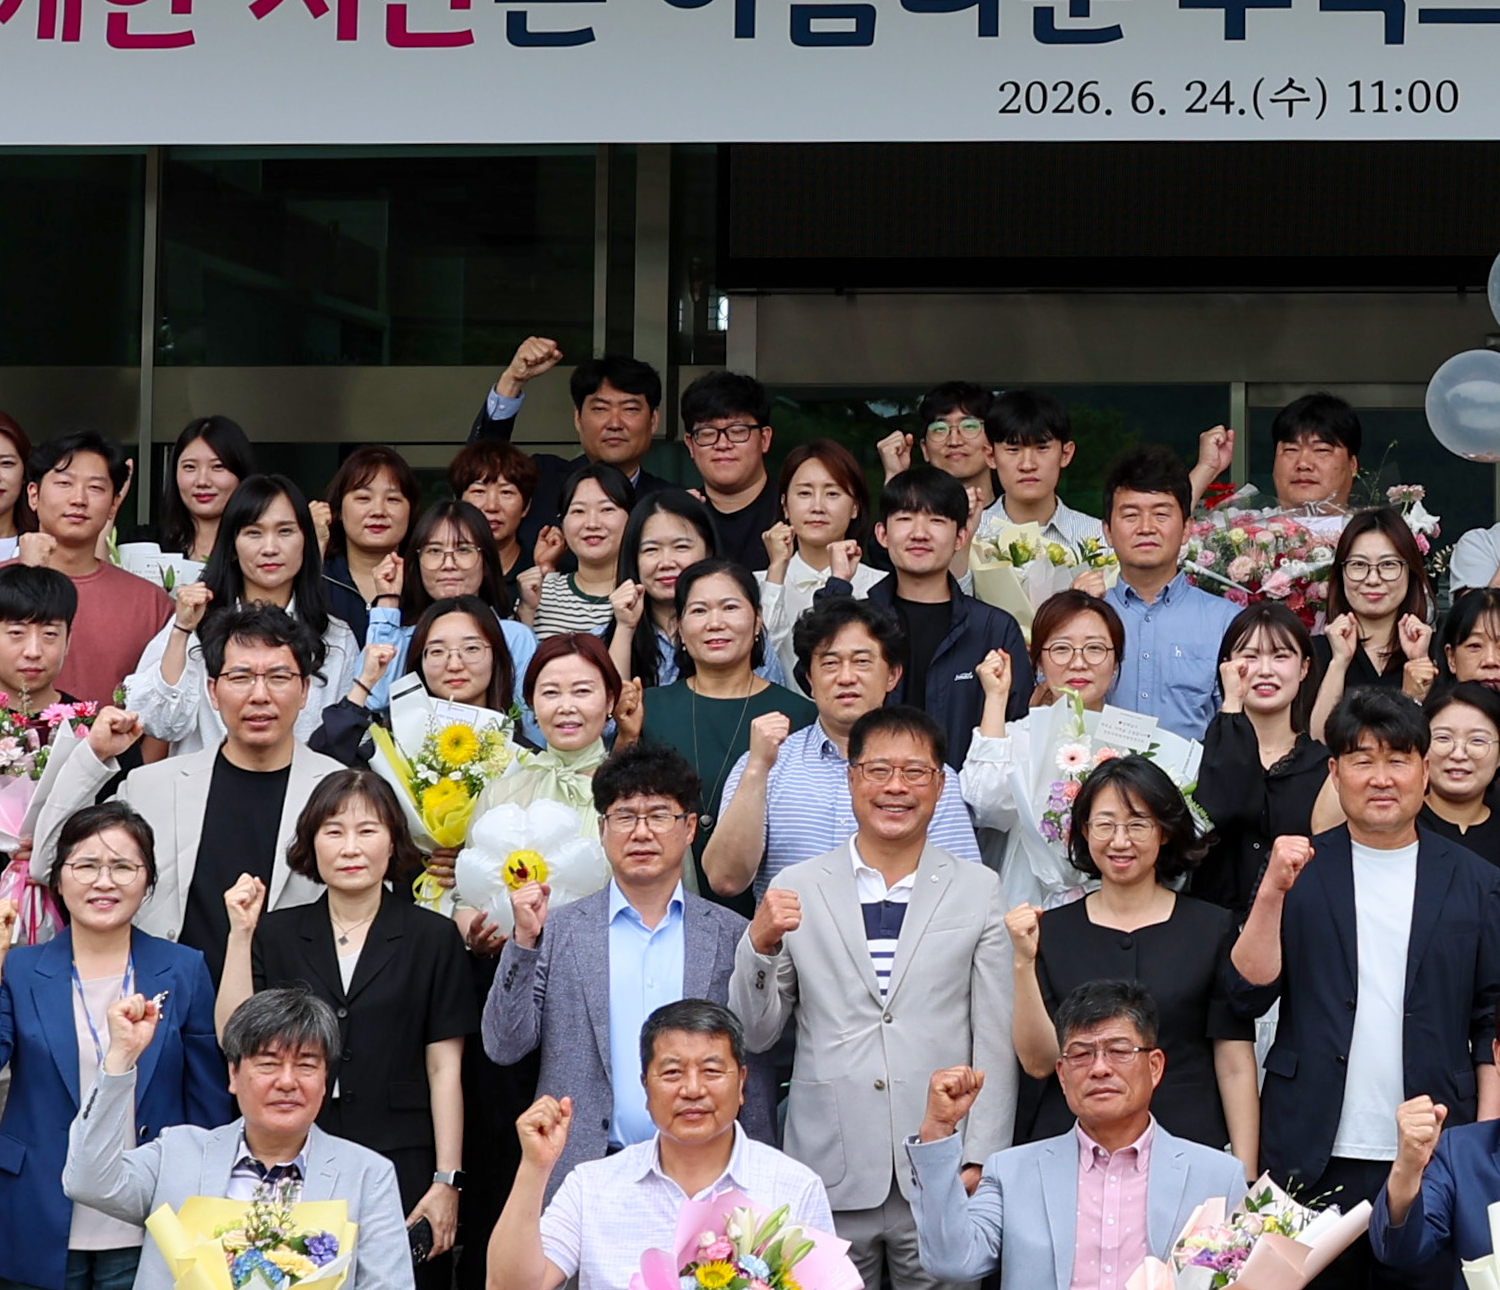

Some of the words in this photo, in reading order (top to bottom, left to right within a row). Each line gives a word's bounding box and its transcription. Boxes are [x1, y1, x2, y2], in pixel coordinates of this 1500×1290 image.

[998, 80, 1113, 117] 2026.
[1130, 80, 1167, 116] 6.
[1184, 76, 1327, 121] 24.(수)
[1347, 79, 1459, 114] 11:00
